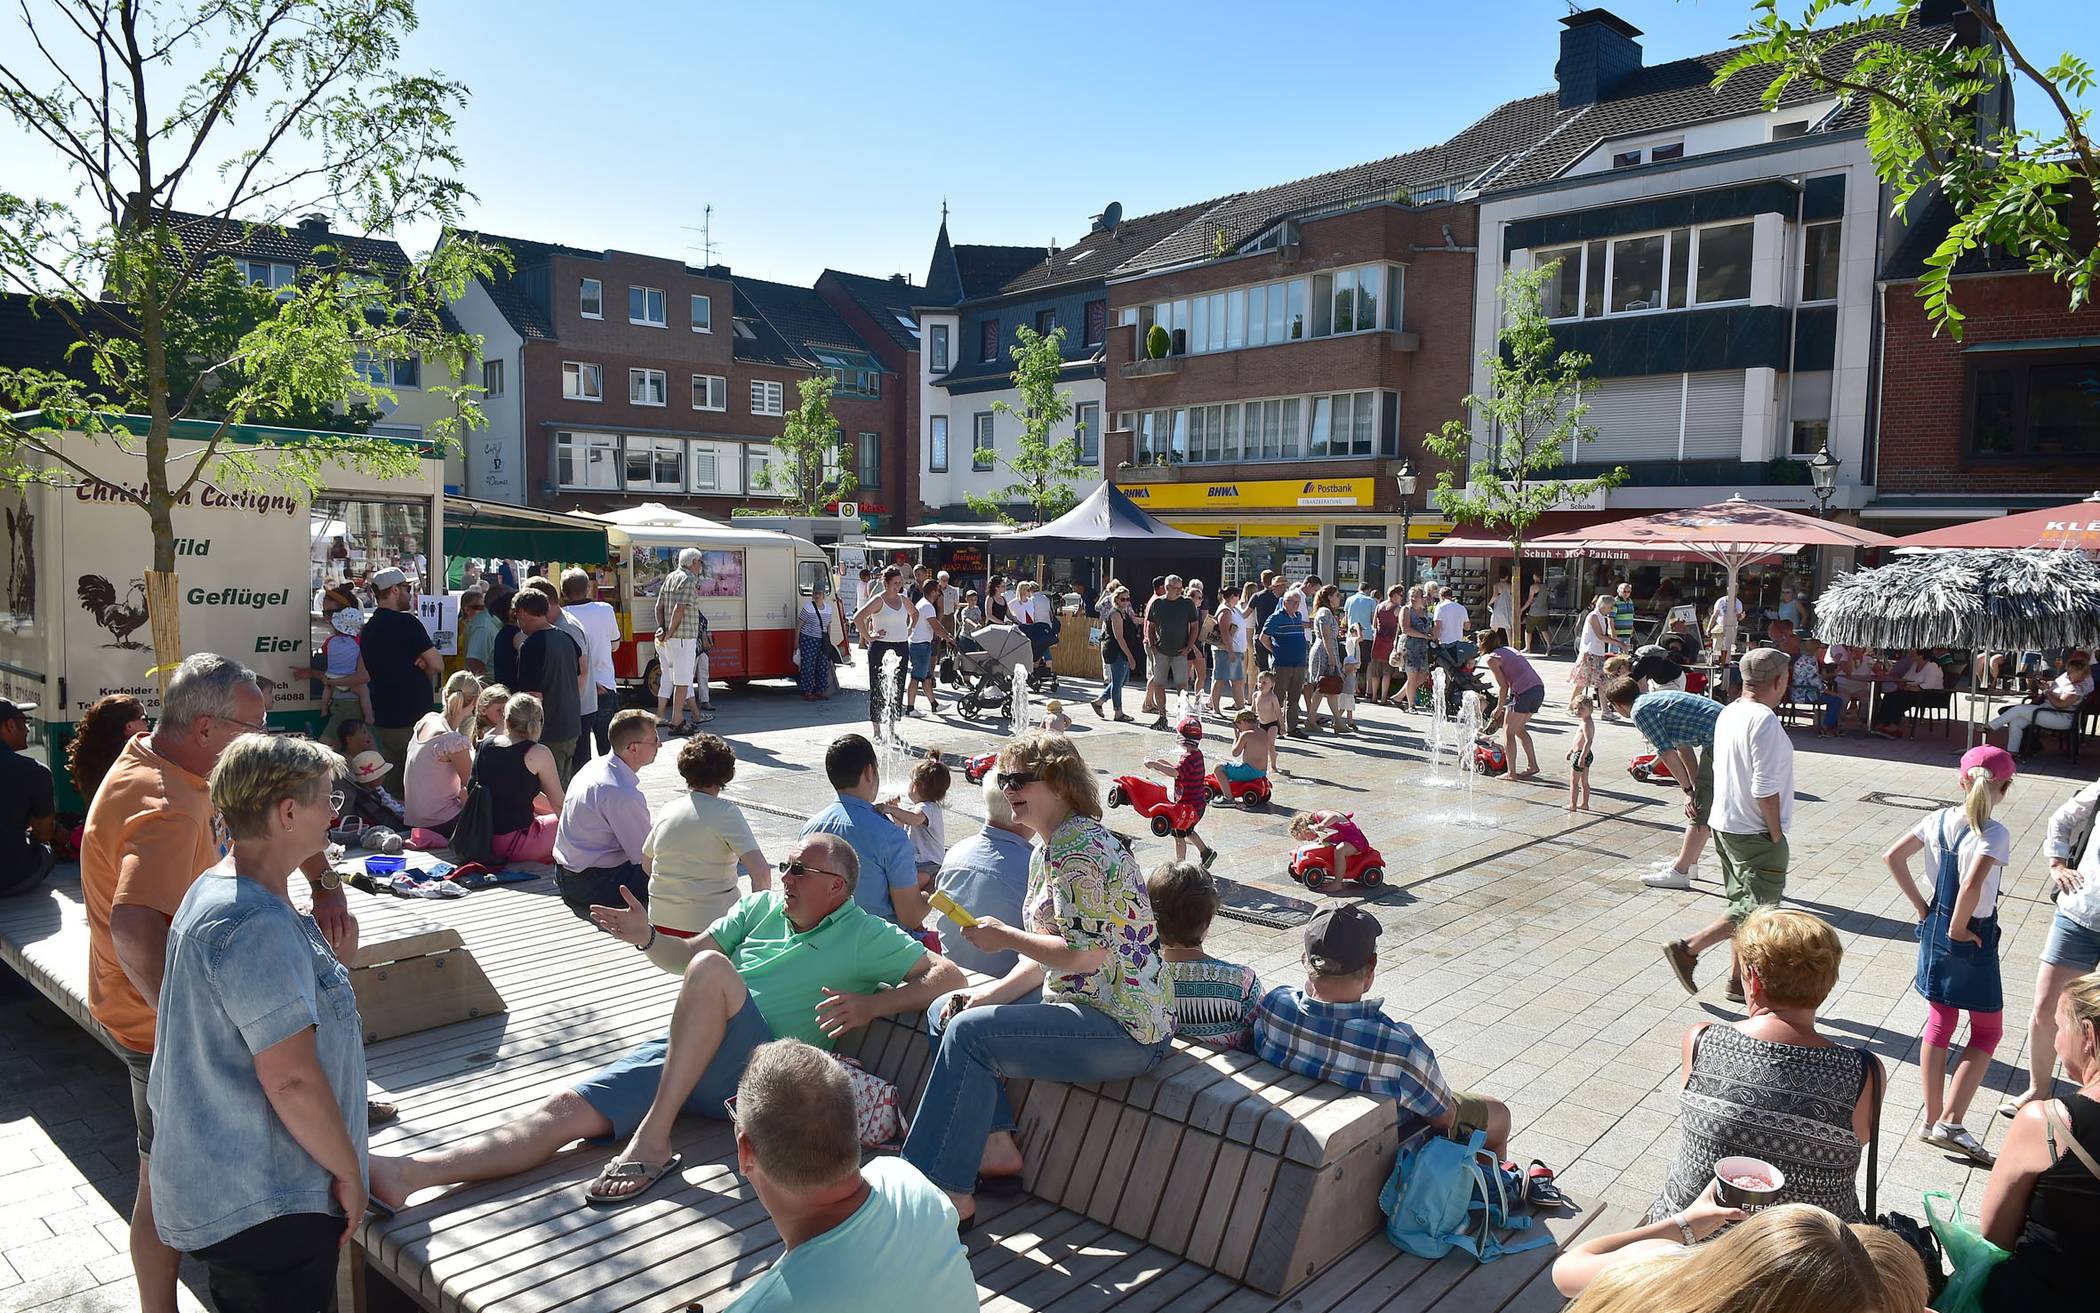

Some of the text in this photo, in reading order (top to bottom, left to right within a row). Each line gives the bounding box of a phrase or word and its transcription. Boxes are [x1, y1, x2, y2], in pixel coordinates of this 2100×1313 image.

[75, 478, 191, 503] Christn
[1317, 483, 1352, 493] Postbank
[845, 505, 852, 514] H
[172, 537, 211, 556] ild
[1523, 549, 1552, 558] Schuh
[1588, 549, 1630, 560] Panknin
[187, 587, 289, 609] Geflügel
[255, 636, 302, 653] Eier
[100, 687, 153, 697] Krefelder
